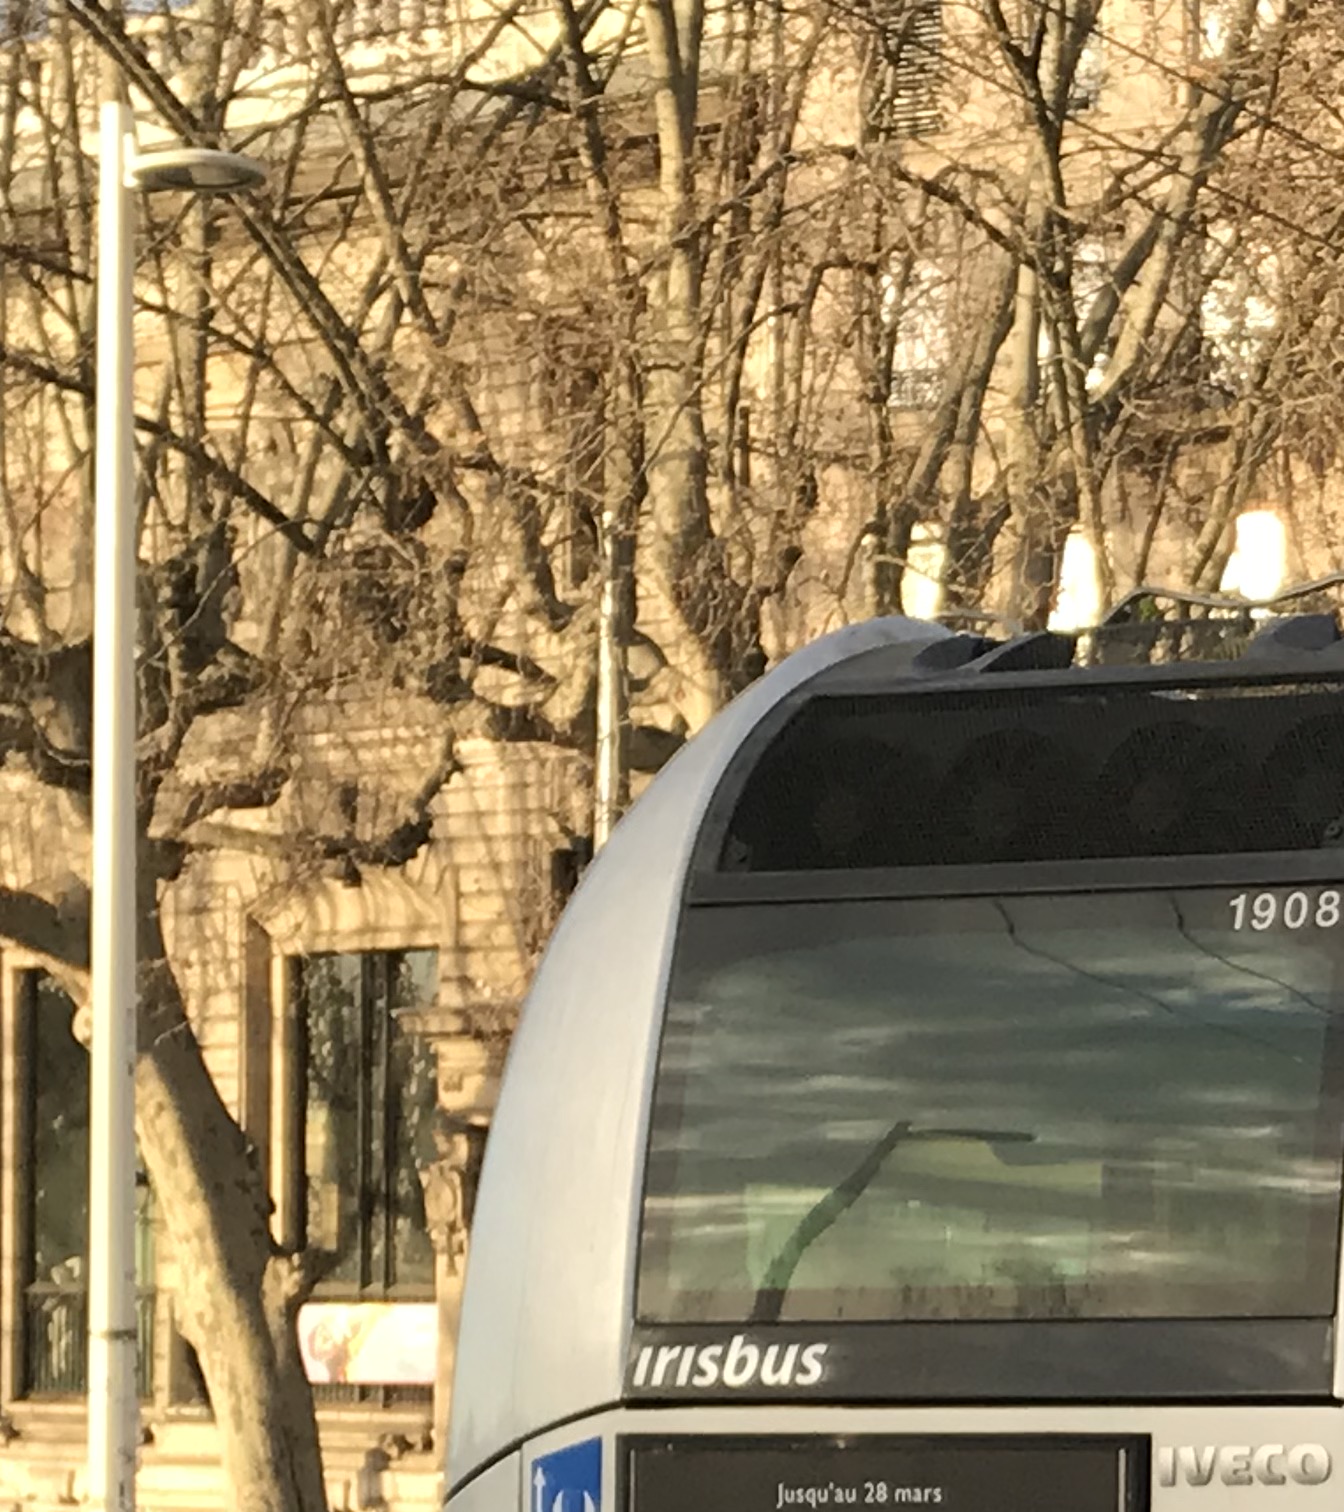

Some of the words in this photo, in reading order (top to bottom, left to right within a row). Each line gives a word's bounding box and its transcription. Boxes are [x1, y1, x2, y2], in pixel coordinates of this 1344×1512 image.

[1229, 890, 1340, 931] 1908
[633, 1333, 828, 1388] irisbus
[1158, 1443, 1332, 1487] IVECO
[776, 1483, 857, 1509] Jusqu'au
[864, 1482, 888, 1503] 28
[894, 1487, 943, 1503] mars
